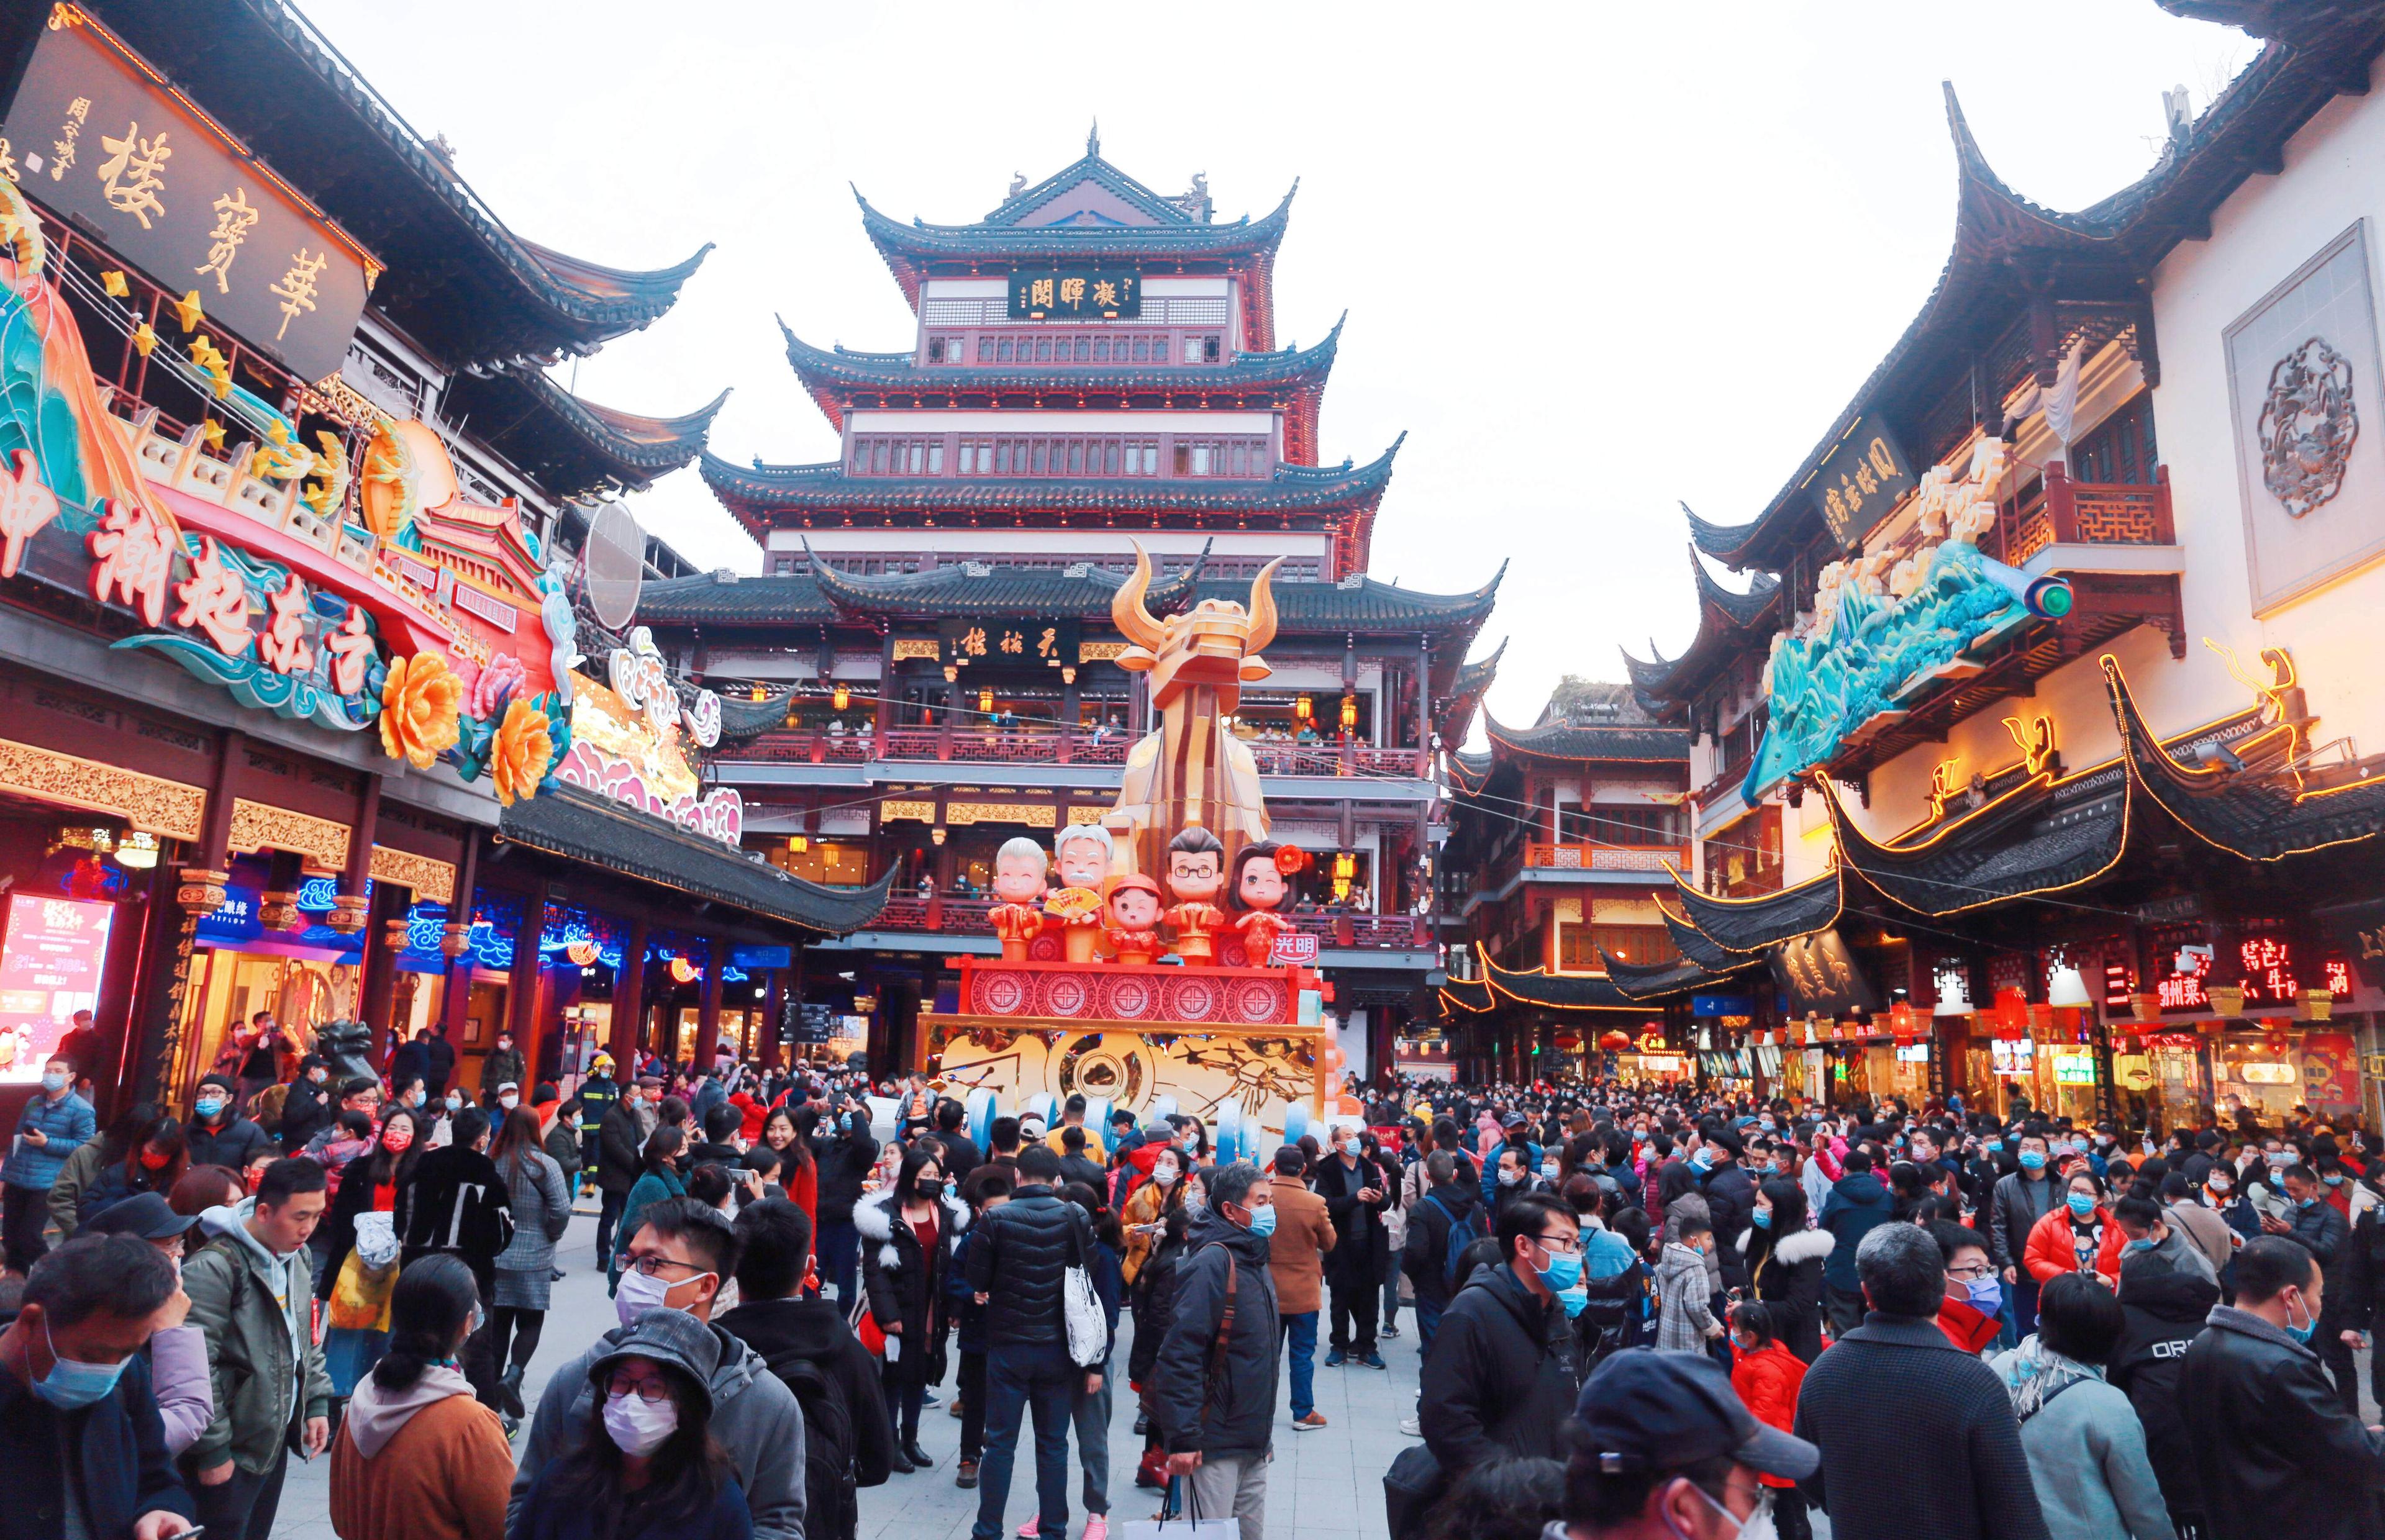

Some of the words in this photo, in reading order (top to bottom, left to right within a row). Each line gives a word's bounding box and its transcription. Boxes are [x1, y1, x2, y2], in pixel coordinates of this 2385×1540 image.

[217, 900, 248, 917] 酿缘
[1275, 936, 1315, 954] 光明
[2151, 1339, 2194, 1358] OR
